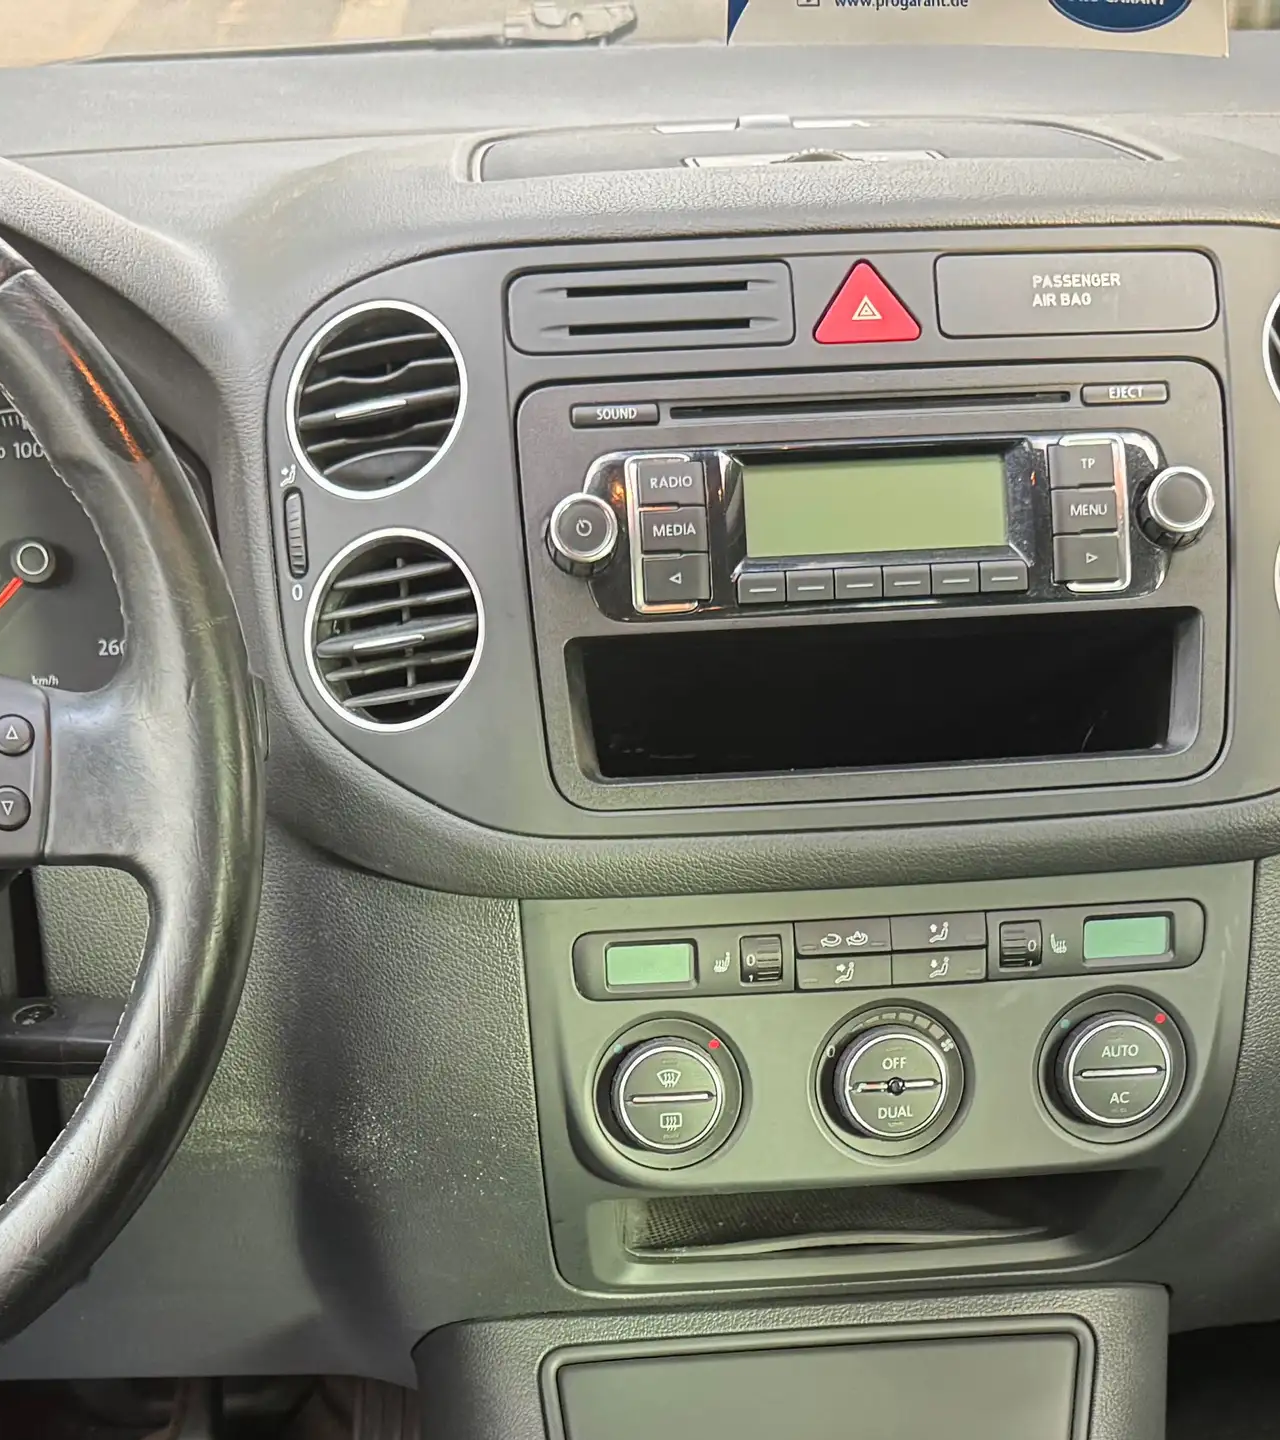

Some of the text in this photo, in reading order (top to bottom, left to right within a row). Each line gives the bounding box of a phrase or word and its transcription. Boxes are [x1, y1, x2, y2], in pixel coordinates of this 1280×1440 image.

[1032, 272, 1121, 289] PASSENGER
[1032, 291, 1092, 307] AIR BAG
[1108, 386, 1144, 399] EJECT
[596, 407, 637, 421] SOUND
[1080, 457, 1096, 470] TP
[650, 476, 693, 489] RADIO
[1070, 503, 1108, 516] MENU
[652, 523, 697, 537] MEDIA
[1101, 1044, 1140, 1058] AUTO
[881, 1056, 908, 1070] OFF
[1109, 1091, 1131, 1104] AC
[877, 1104, 914, 1120] DUAL
